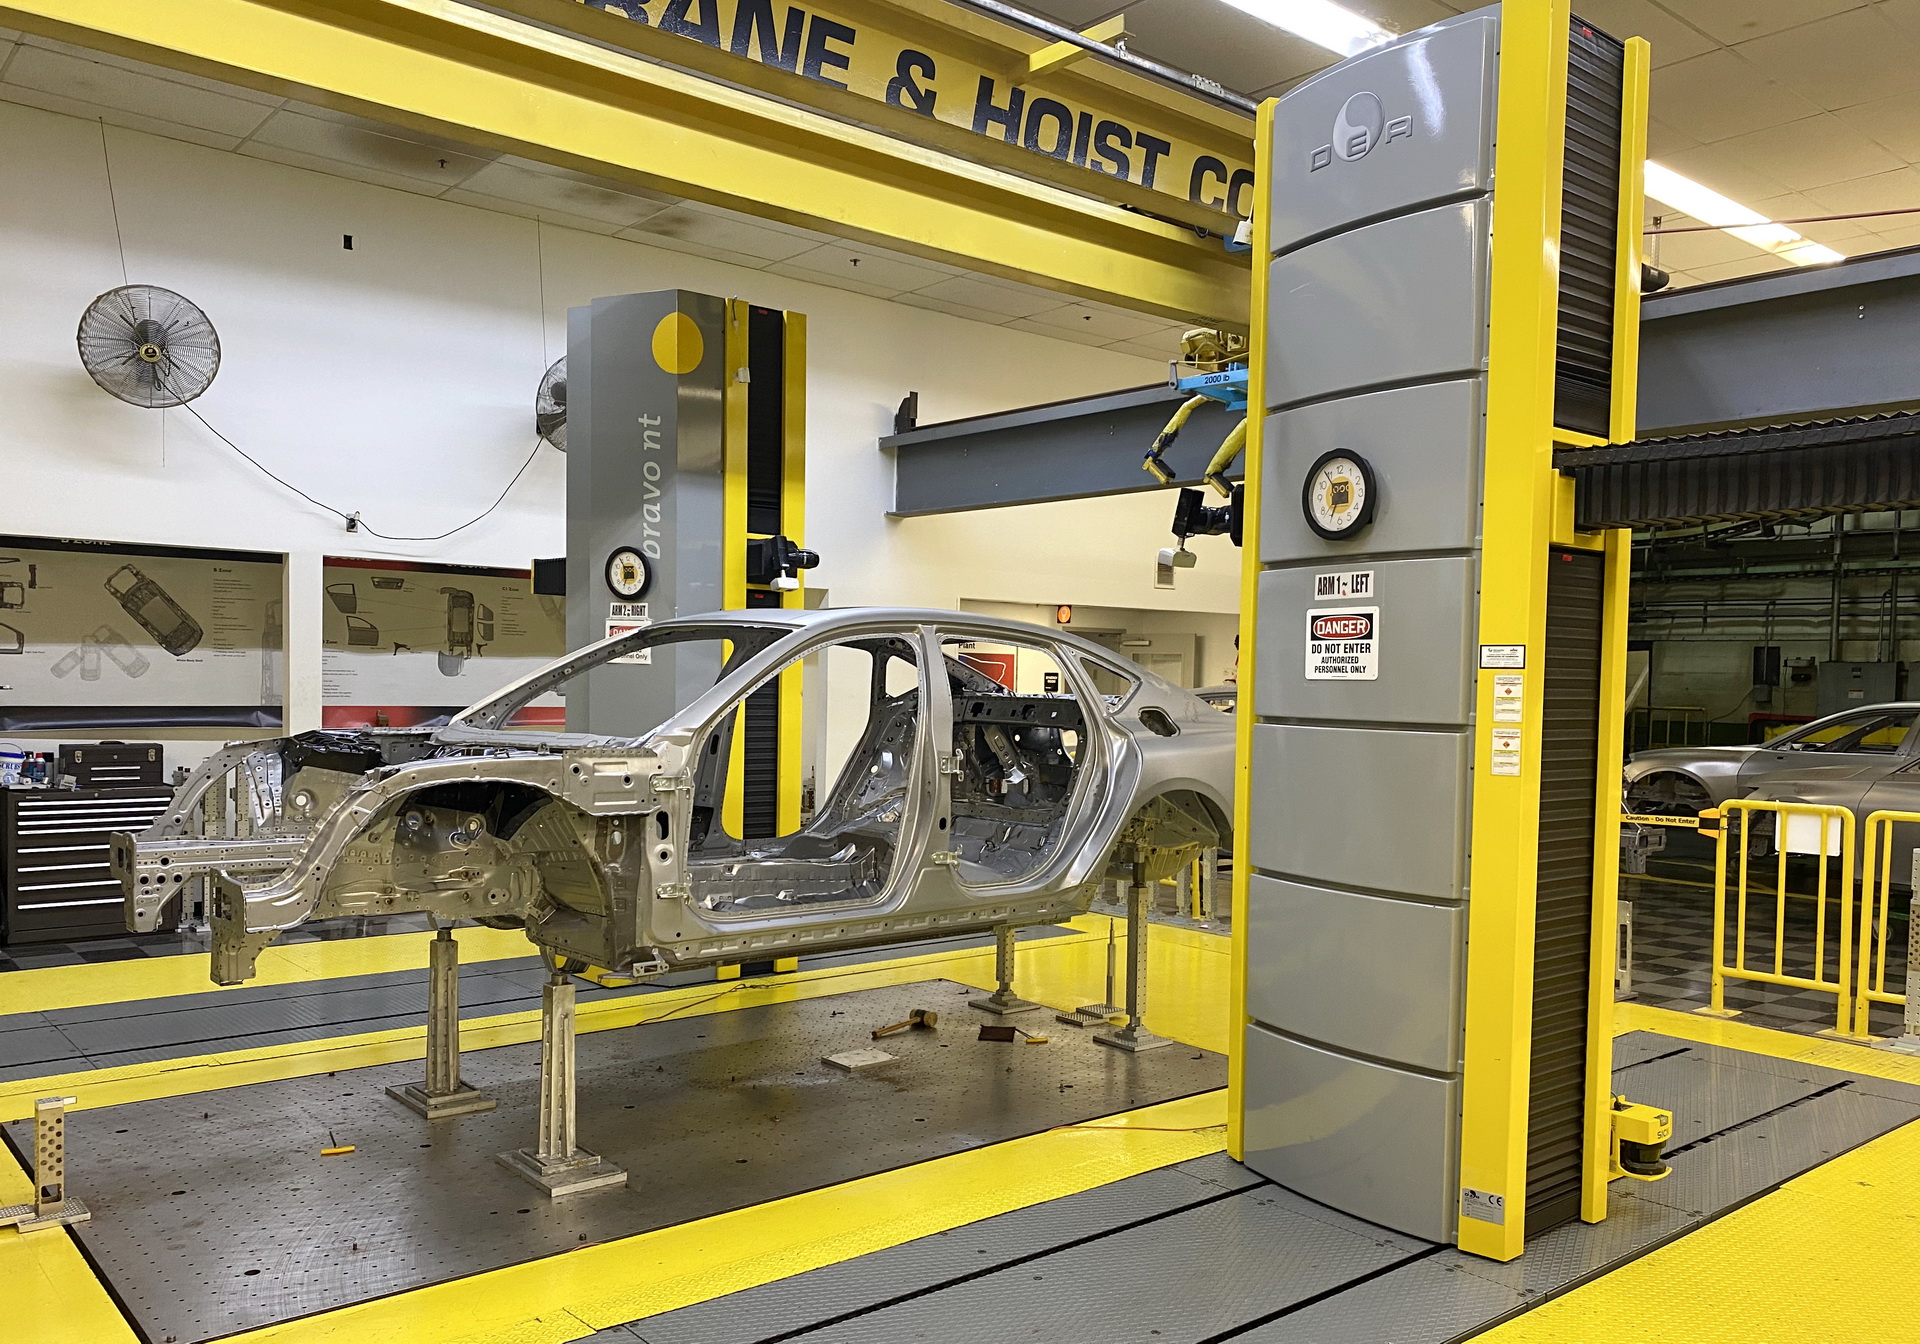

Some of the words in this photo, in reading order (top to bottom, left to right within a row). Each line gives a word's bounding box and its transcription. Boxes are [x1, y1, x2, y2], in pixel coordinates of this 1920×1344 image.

[886, 49, 937, 120] &
[971, 75, 1171, 190] HOIST
[1310, 115, 1413, 173] DEA
[1204, 374, 1222, 384] 2000
[638, 413, 662, 450] nt
[1336, 464, 1344, 474] 12
[1319, 481, 1327, 490] 10
[642, 461, 661, 560] bravo
[1317, 576, 1334, 595] ARM
[1336, 575, 1340, 594] 1
[1351, 574, 1370, 593] LEFT
[612, 605, 622, 615] ARM
[631, 605, 646, 616] RIGHT
[1317, 620, 1366, 634] DANGER
[1312, 644, 1322, 654] DO
[1325, 643, 1341, 654] NOT
[1344, 643, 1371, 653] ENTER
